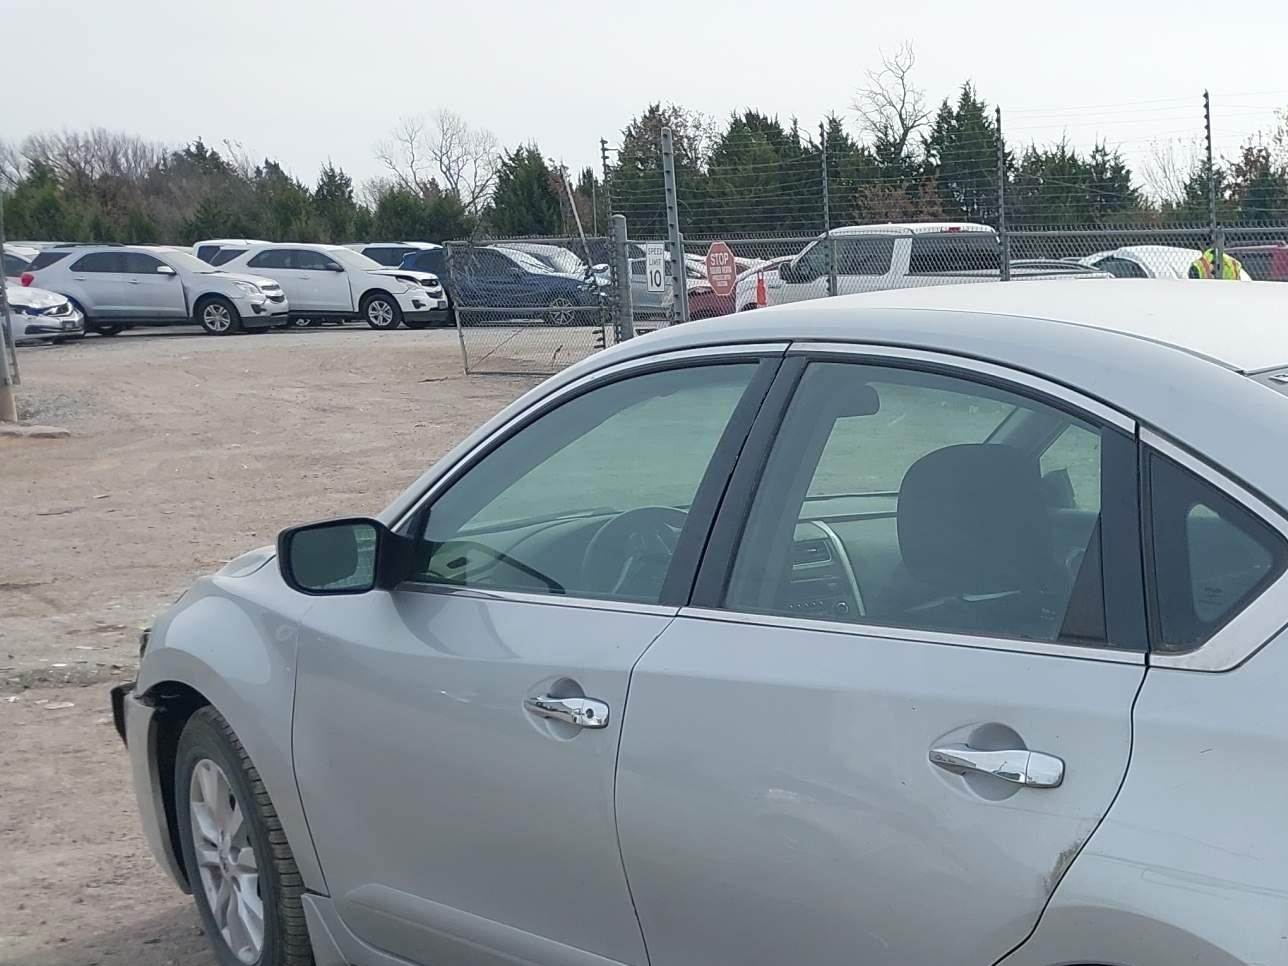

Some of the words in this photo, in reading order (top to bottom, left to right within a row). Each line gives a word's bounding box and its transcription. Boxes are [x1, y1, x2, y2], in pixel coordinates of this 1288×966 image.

[647, 247, 663, 256] SPEED
[648, 258, 662, 266] LIMIT
[710, 252, 729, 266] STOP
[649, 269, 662, 287] 10
